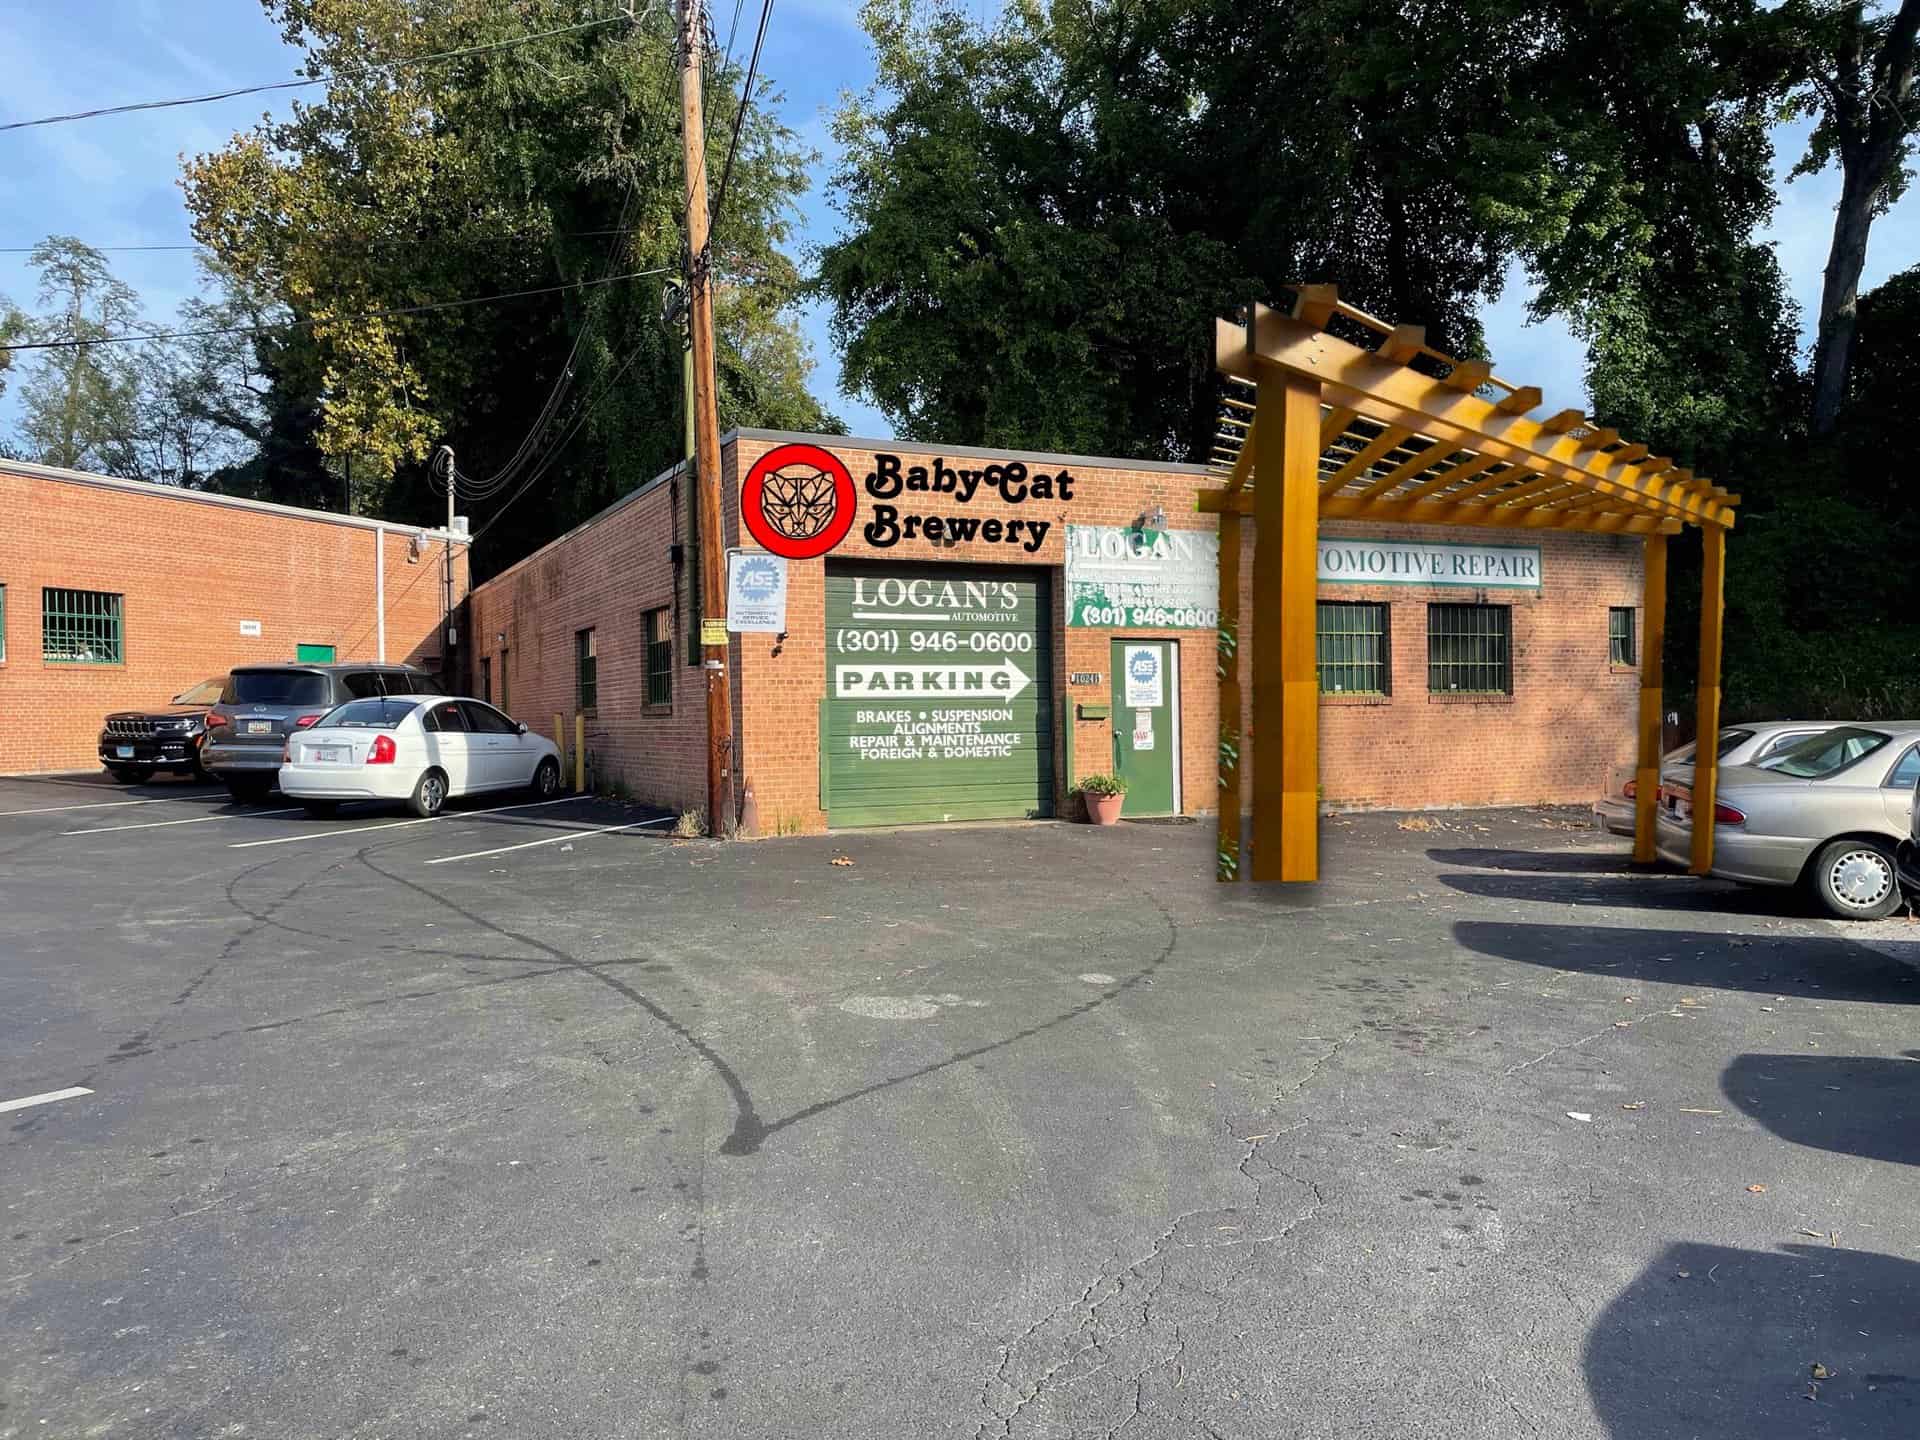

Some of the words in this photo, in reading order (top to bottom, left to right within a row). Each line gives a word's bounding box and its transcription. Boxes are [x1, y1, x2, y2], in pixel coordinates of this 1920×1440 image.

[1319, 549, 1445, 575] OMOTIVE
[1453, 553, 1535, 578] REPAIR
[741, 570, 774, 586] ASE
[852, 577, 1019, 609] LOGAN'S
[951, 612, 1019, 622] AUTOMOTIVE
[1082, 606, 1127, 627] (301)
[836, 629, 899, 654] (301)
[910, 631, 1032, 652] 946-0600
[843, 671, 1011, 690] PARKING
[856, 711, 911, 723] BRAKES
[931, 709, 1013, 722] SUSPENSION
[893, 722, 981, 735] ALIGNMENTS
[849, 736, 898, 748] REPAIR
[904, 735, 915, 747] &
[921, 733, 1021, 746] MAINTENANCE
[860, 748, 922, 760] FOREIGN
[927, 747, 938, 759] &
[944, 745, 1012, 758] DOMESTIC
